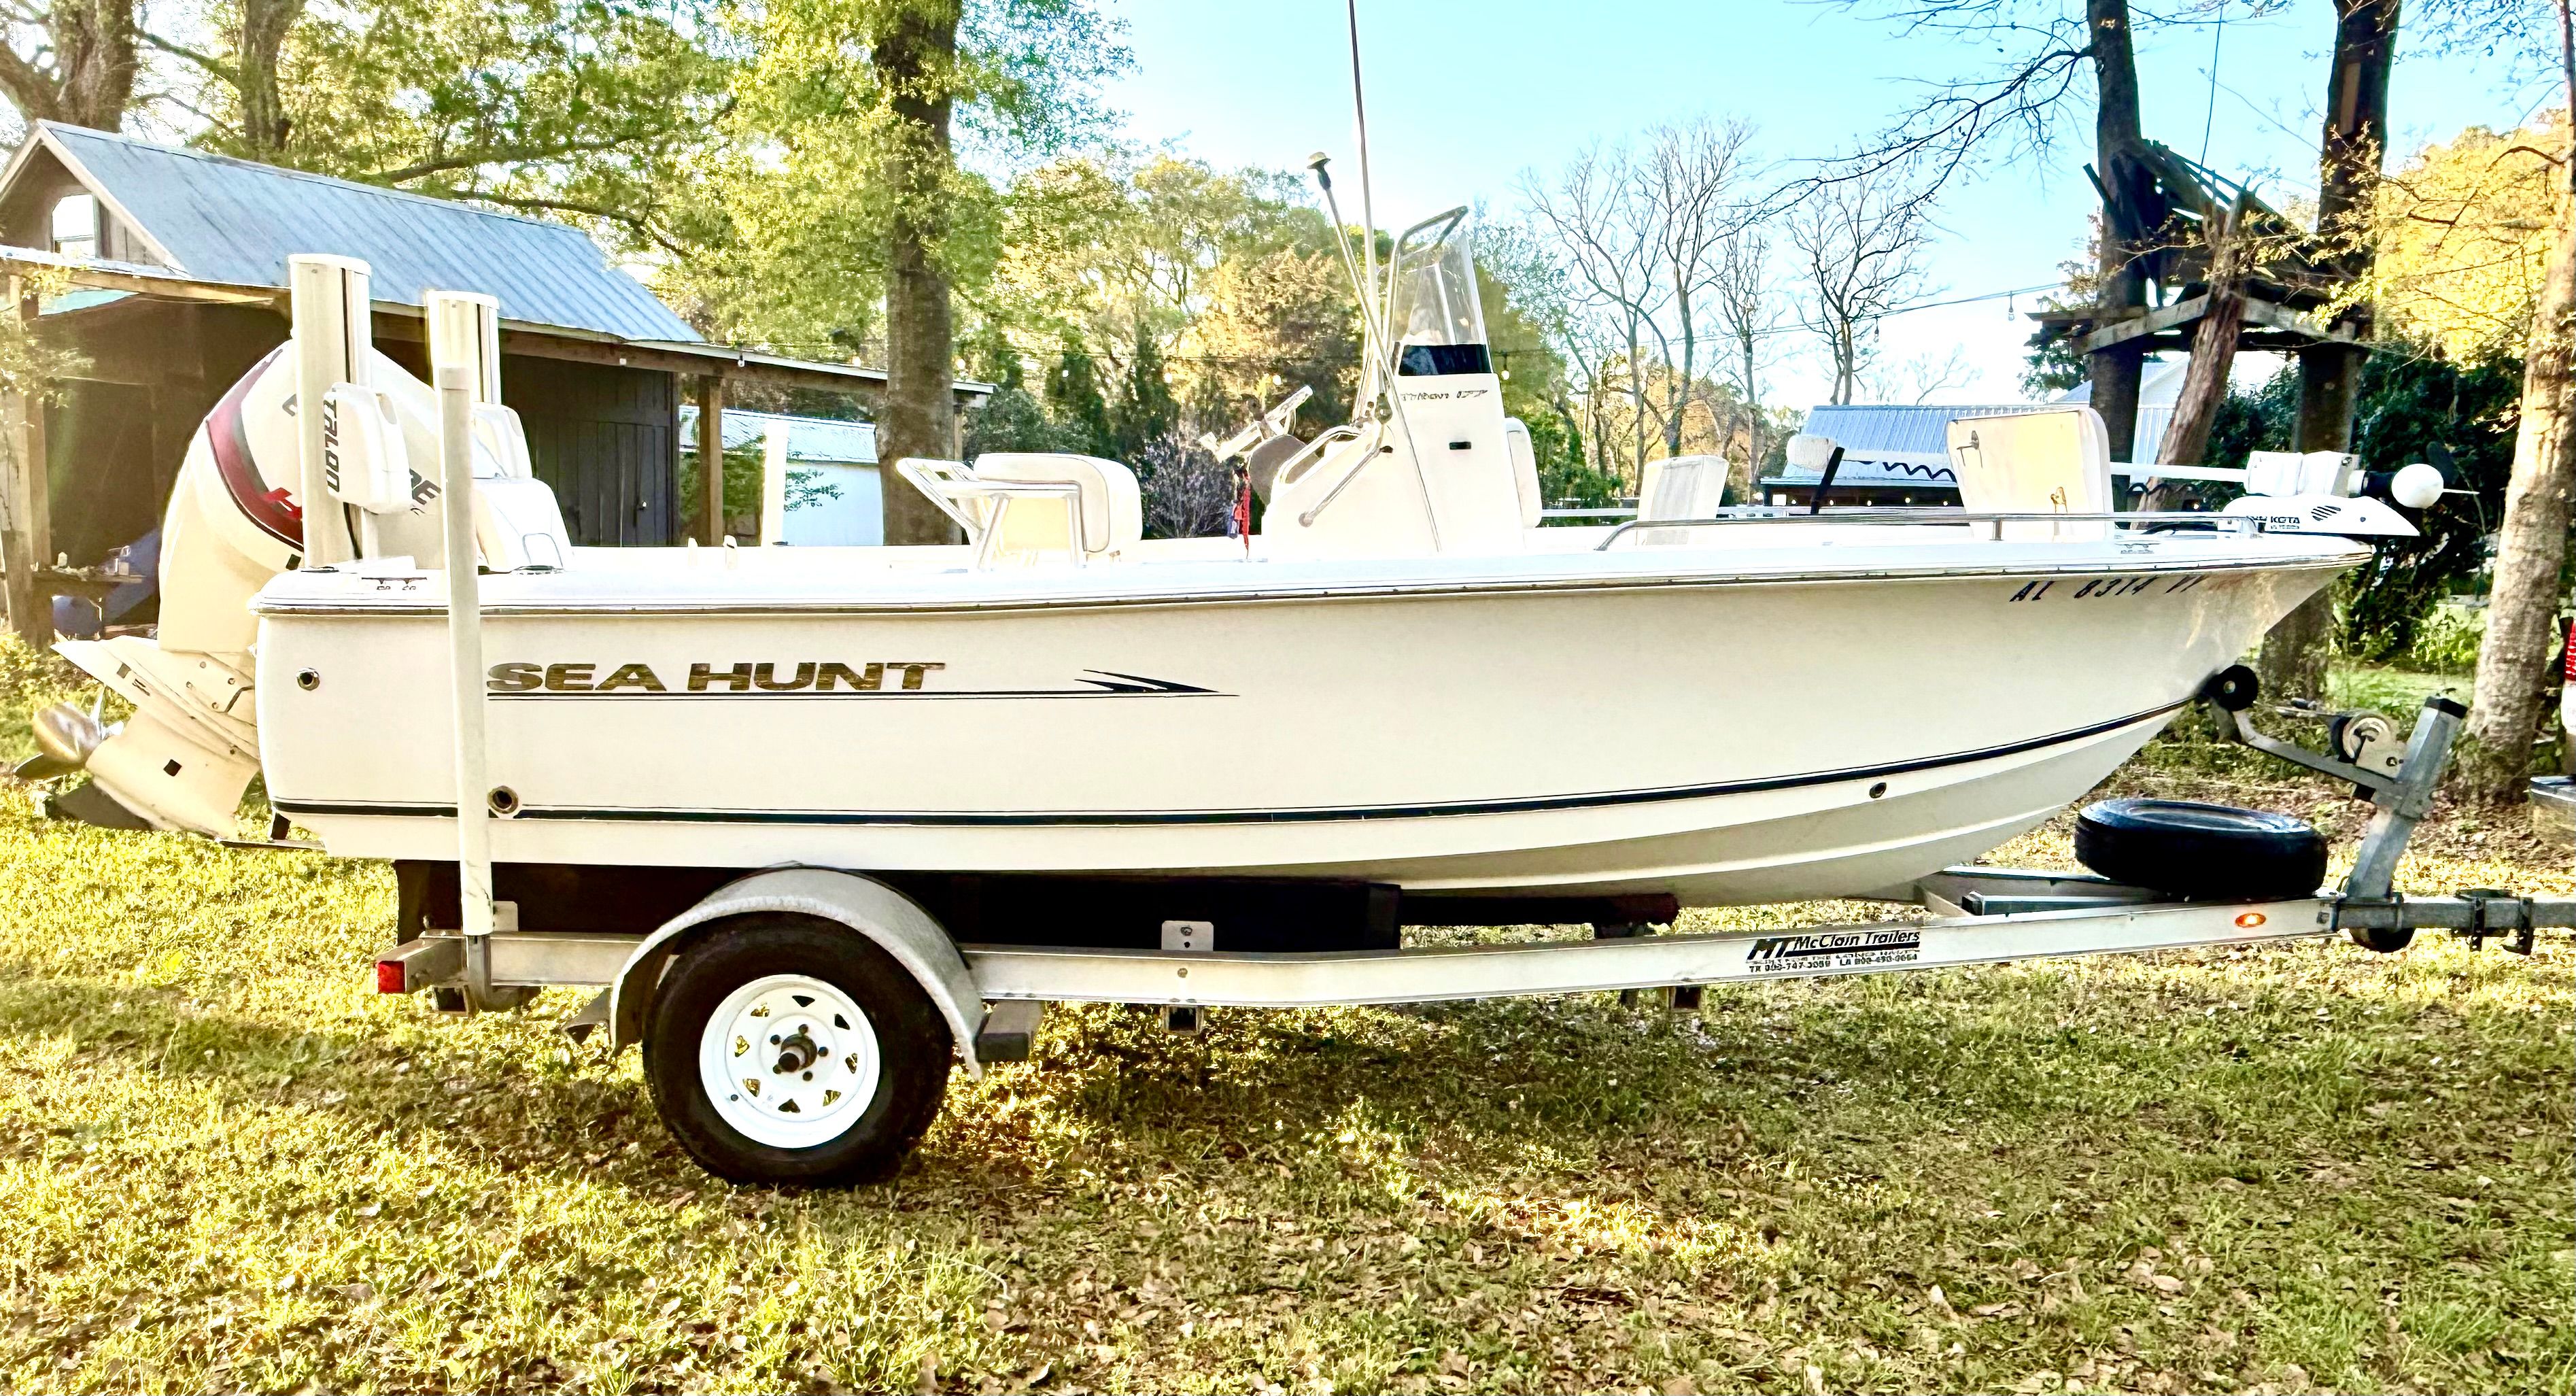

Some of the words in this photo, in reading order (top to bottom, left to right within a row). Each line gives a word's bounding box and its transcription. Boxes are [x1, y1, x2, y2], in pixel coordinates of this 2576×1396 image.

[2270, 515, 2300, 524] KOTA
[486, 662, 667, 692] SEA
[687, 662, 946, 692] HUNT
[1793, 934, 1860, 951] McClain
[1865, 930, 1921, 944] Trailers
